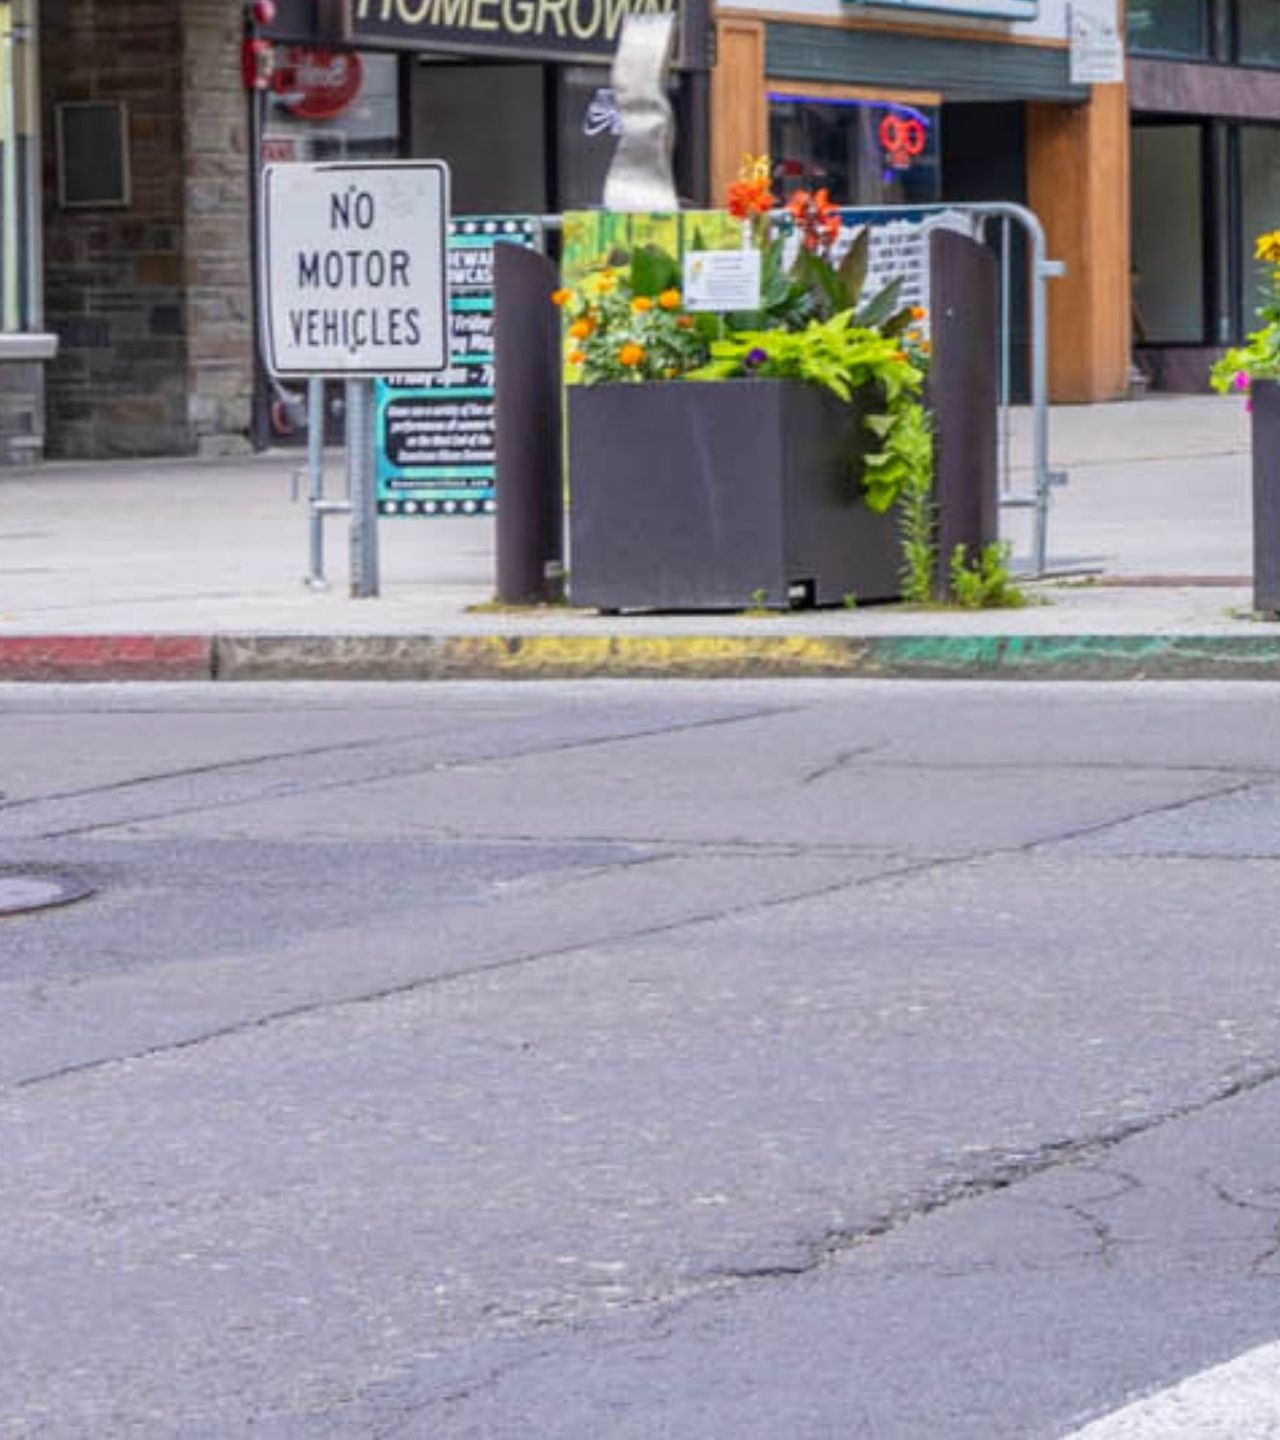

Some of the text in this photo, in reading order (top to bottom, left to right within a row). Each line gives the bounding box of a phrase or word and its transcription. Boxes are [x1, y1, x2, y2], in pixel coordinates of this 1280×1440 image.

[331, 191, 374, 230] NO
[298, 249, 411, 290] MOTOR
[289, 307, 421, 347] VEHICLES
